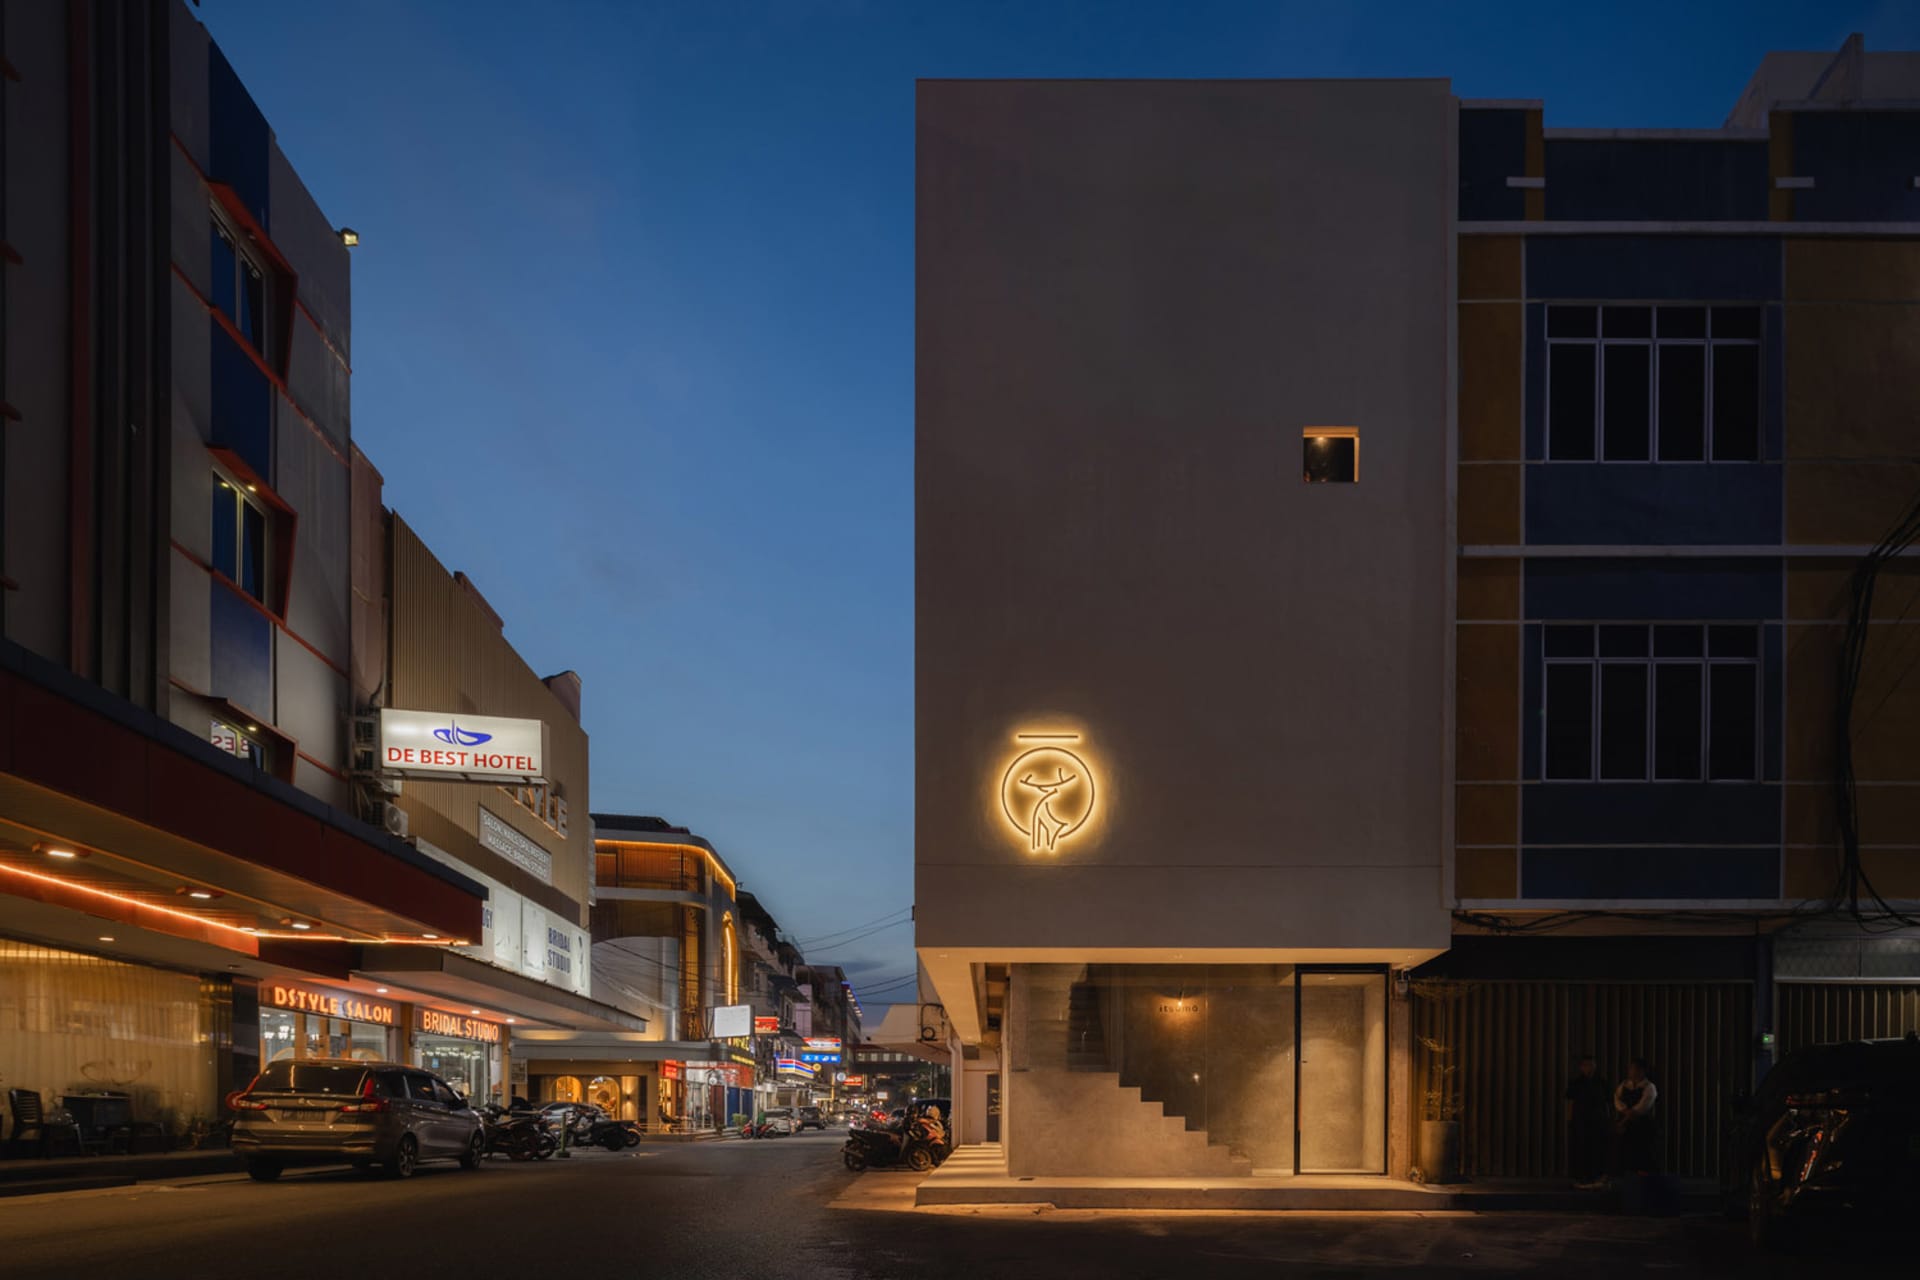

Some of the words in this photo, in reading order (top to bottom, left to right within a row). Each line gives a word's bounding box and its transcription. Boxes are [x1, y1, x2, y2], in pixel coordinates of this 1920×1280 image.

[387, 747, 415, 763] DE
[419, 750, 469, 766] BEST
[473, 753, 537, 771] HOTEL
[548, 930, 571, 953] BRIDAL
[547, 949, 571, 974] STUDIO
[274, 985, 339, 1015] DSTYLE
[345, 1000, 393, 1024] SALON
[423, 1011, 463, 1035] BRIDAL
[465, 1018, 499, 1042] STUDIO
